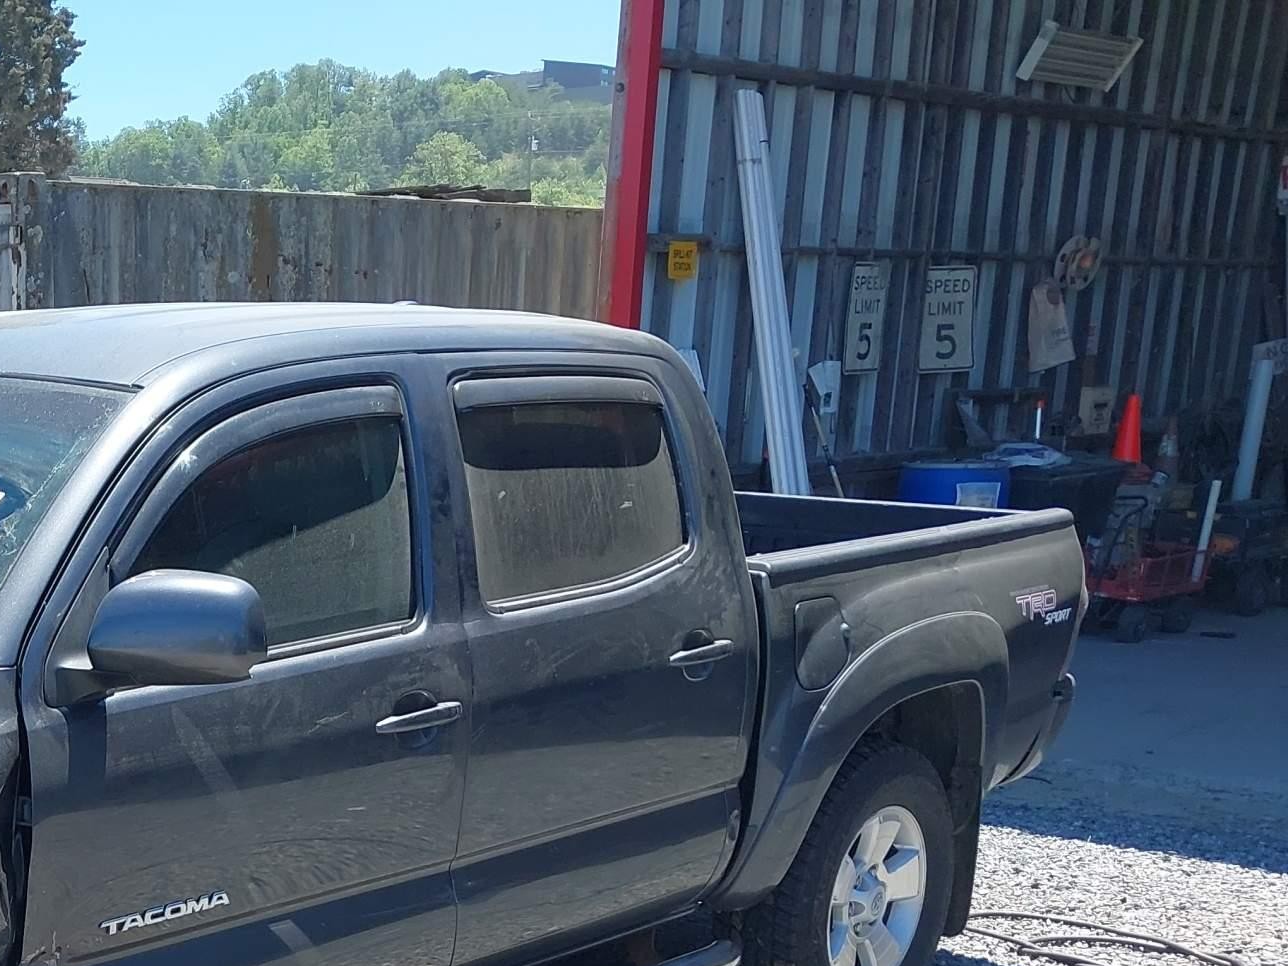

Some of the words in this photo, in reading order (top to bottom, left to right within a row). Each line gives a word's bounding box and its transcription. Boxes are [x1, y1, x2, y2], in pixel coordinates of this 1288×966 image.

[854, 275, 887, 291] SPEED
[925, 279, 971, 294] SPEED
[854, 299, 881, 314] LIMIT
[927, 301, 965, 316] LIMIT
[856, 322, 873, 360] 5
[935, 323, 957, 360] 5
[1015, 589, 1056, 621] TRD
[1044, 608, 1072, 625] SPORT
[100, 890, 230, 935] TACOMA
